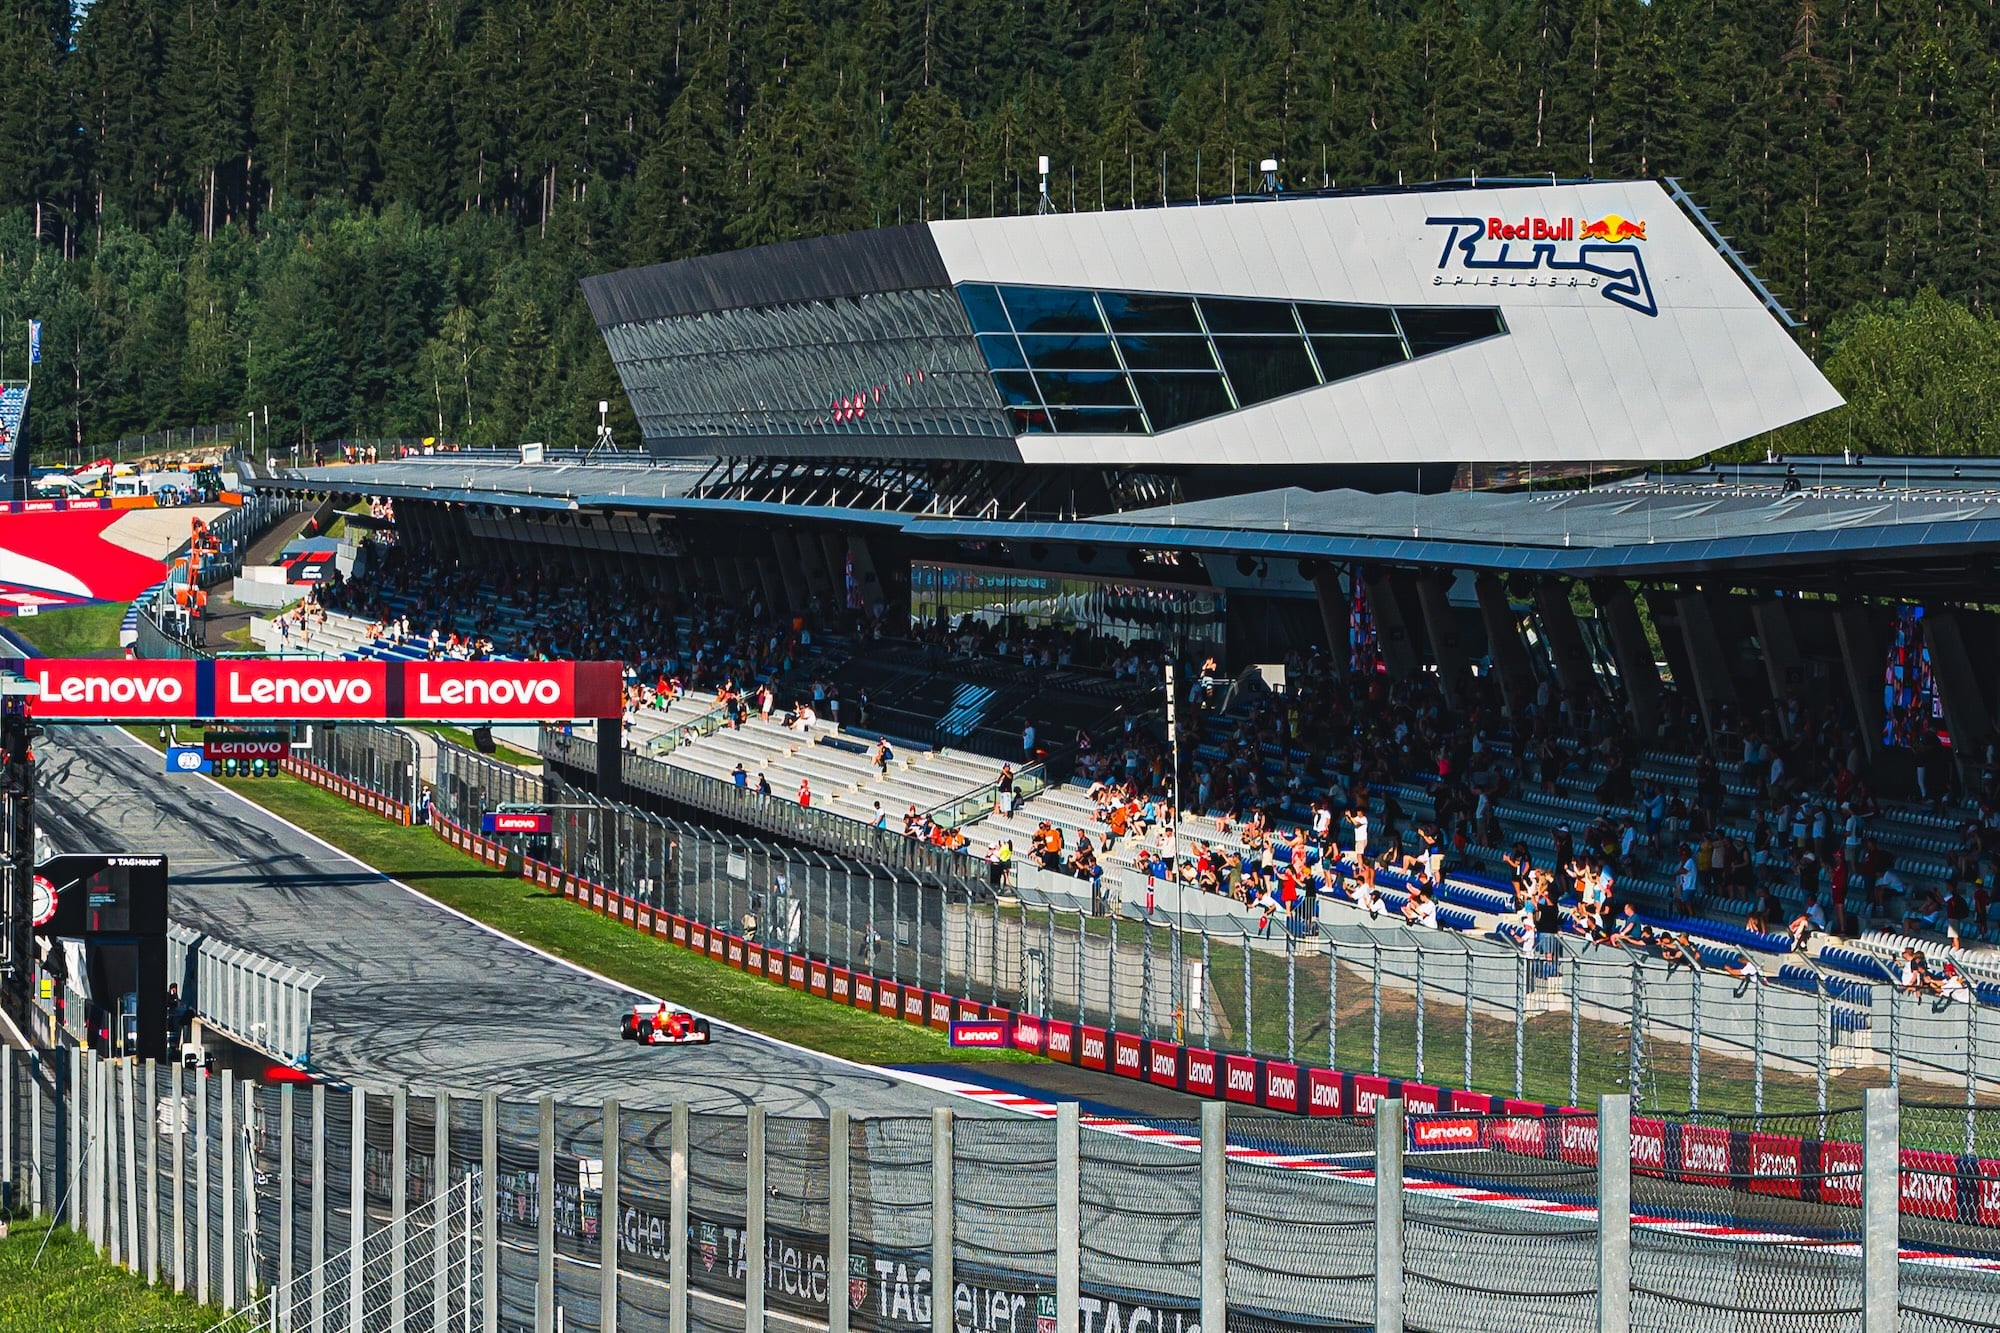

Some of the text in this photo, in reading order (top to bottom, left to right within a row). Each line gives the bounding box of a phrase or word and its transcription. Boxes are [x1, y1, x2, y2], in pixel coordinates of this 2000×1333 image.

[1487, 217, 1573, 241] Red Bull
[1432, 275, 1600, 287] SPIELBERG
[40, 671, 182, 702] Lenovo
[230, 672, 372, 703] Lenovo
[419, 673, 560, 705] Lenovo
[210, 742, 282, 754] Lenovo
[499, 818, 535, 828] Lenovo
[879, 986, 897, 1009] Lenovo
[905, 992, 923, 1016] Lenovo
[931, 998, 950, 1023] Lenovo
[957, 1030, 999, 1042] Lenovo
[1018, 1019, 1039, 1046] Lenovo
[1049, 1027, 1070, 1053] Lenovo
[1082, 1033, 1104, 1060] Lenovo
[1116, 1041, 1139, 1068] Lenovo
[1152, 1048, 1175, 1077] Lenovo
[1188, 1056, 1213, 1085] Lenovo
[1227, 1063, 1254, 1093] Lenovo
[1268, 1070, 1295, 1100] Lenovo
[1311, 1077, 1339, 1108] Lenovo
[1420, 1126, 1473, 1139] Lenovo
[1629, 1134, 1661, 1162] enovo
